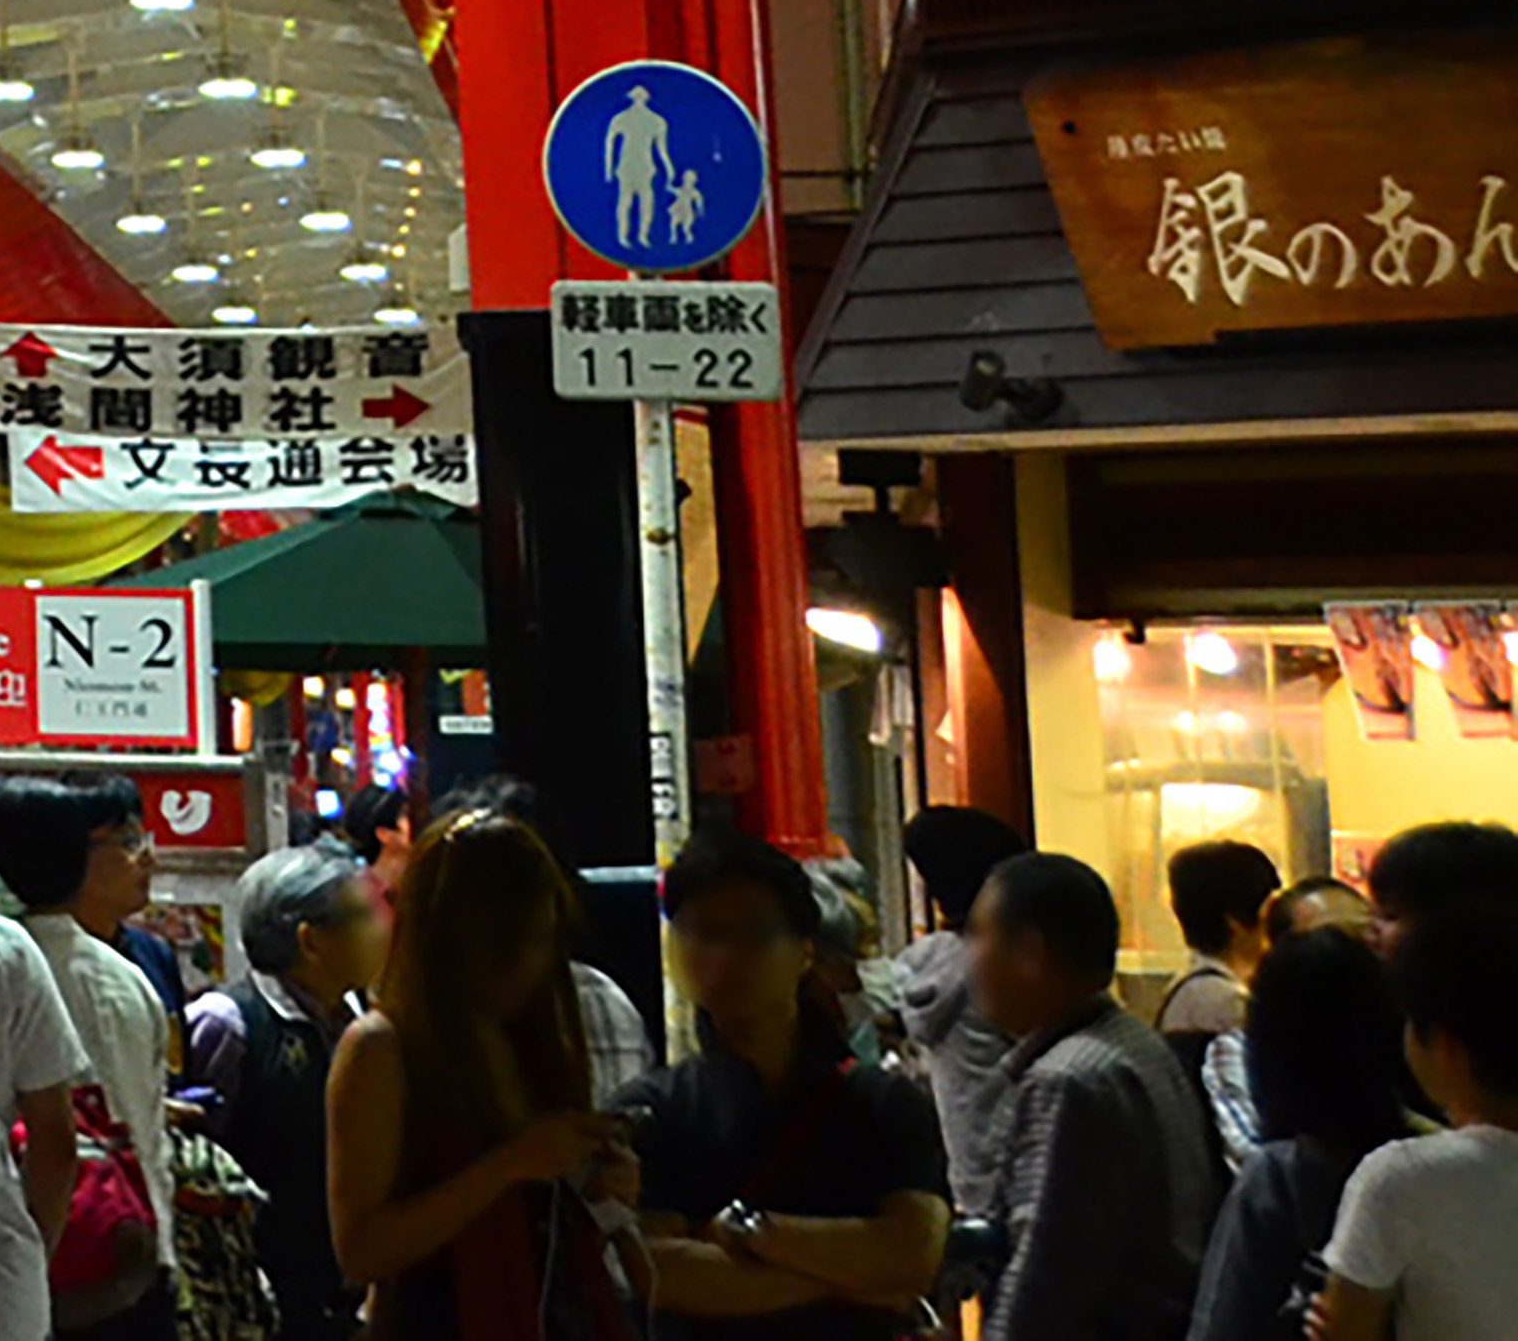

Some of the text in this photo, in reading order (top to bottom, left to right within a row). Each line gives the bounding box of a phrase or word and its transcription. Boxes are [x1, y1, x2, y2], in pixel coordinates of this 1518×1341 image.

[1147, 170, 1518, 308] 銀のあん
[559, 294, 769, 335] 軽車両を除く
[89, 334, 431, 382] 大須観音
[578, 348, 754, 390] 11-22
[0, 383, 337, 433] 浅間神社
